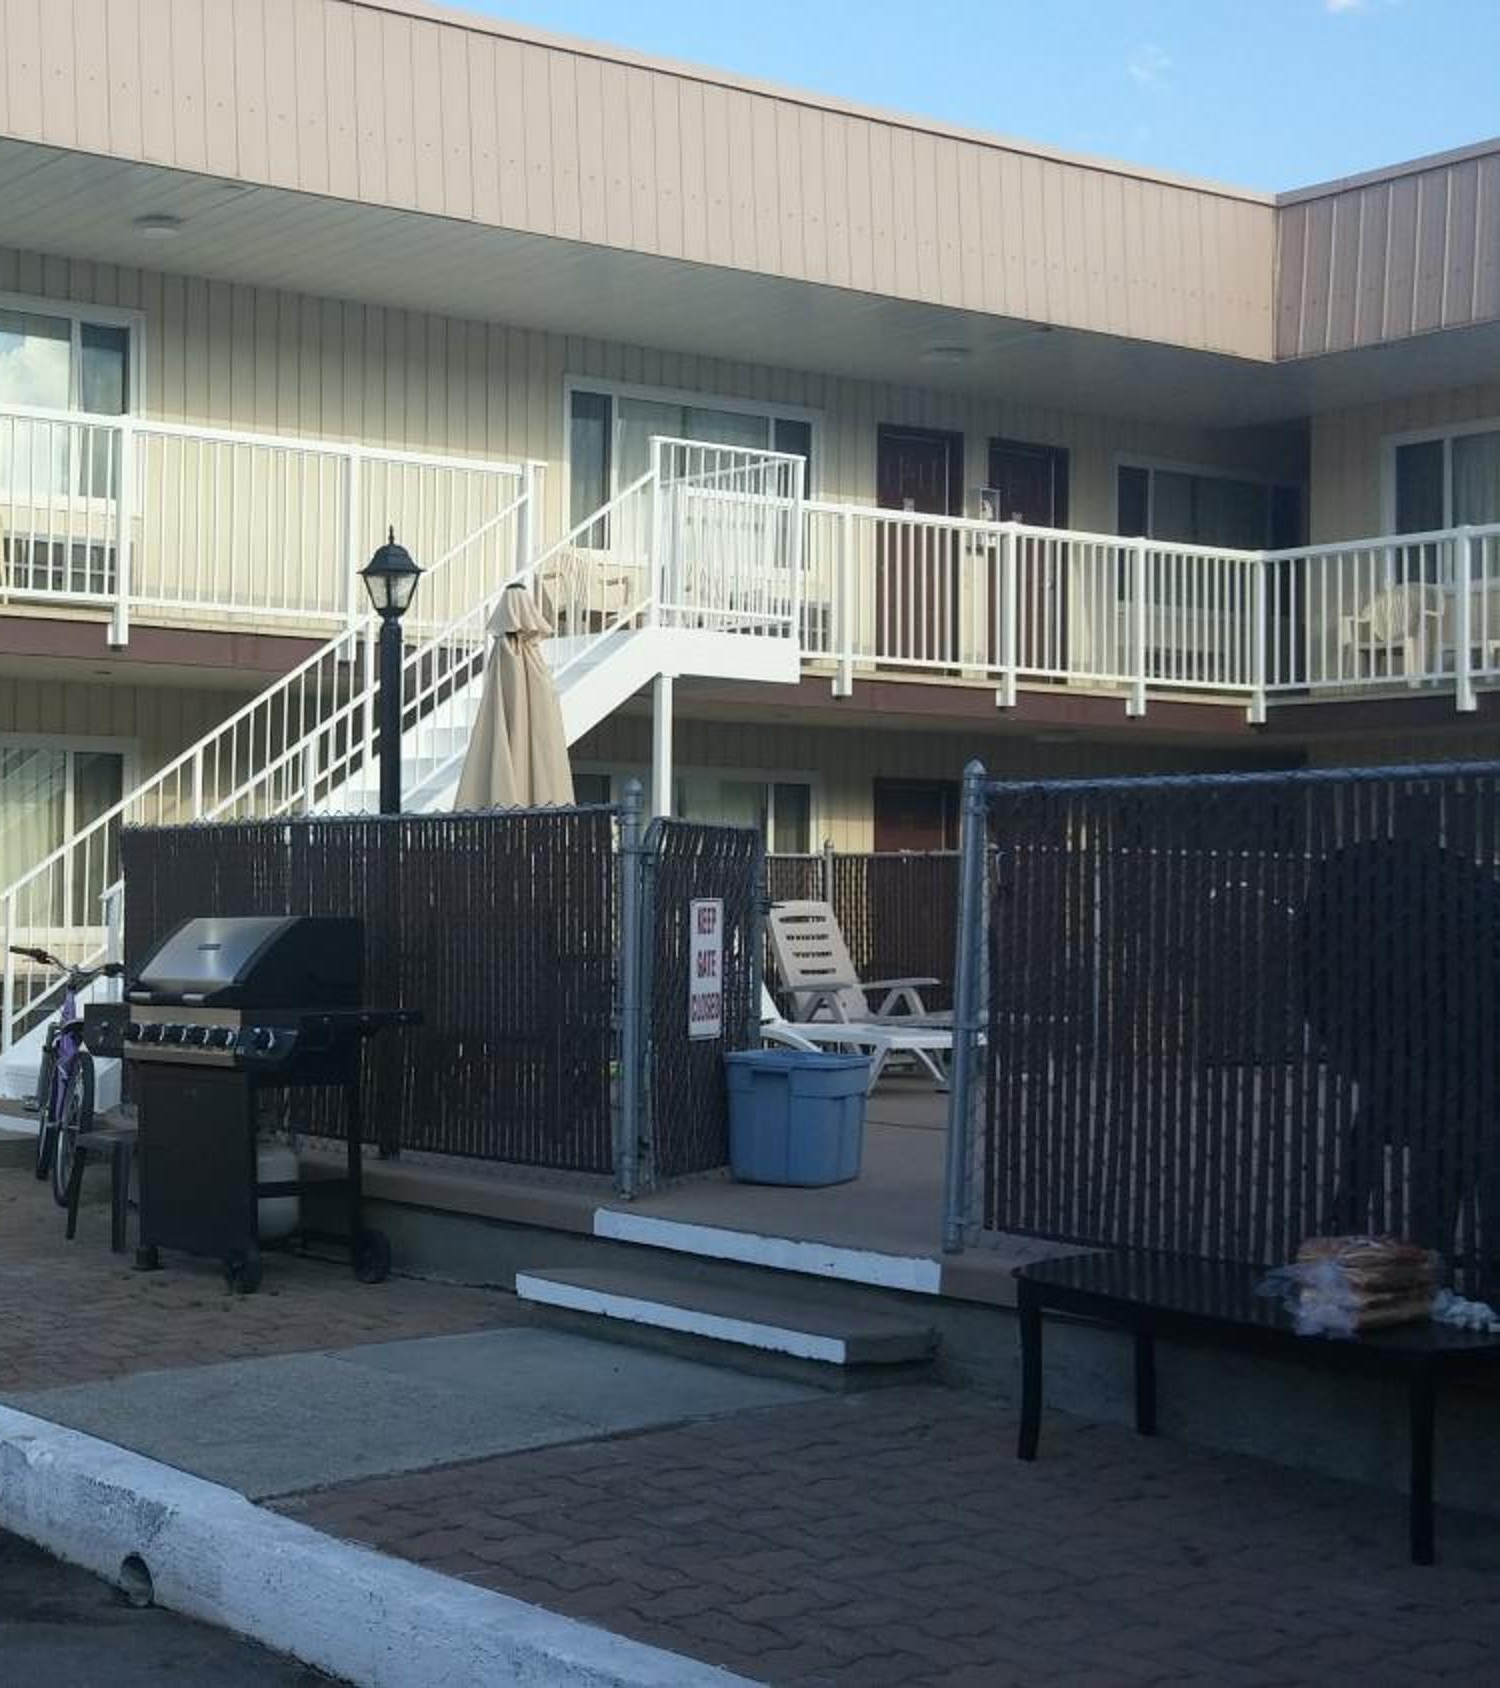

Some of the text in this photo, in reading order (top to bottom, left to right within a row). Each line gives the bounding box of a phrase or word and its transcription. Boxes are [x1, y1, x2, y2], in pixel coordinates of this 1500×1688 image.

[697, 906, 717, 935] KEEP
[697, 950, 717, 978] GATE
[691, 991, 720, 1023] CLOSED
